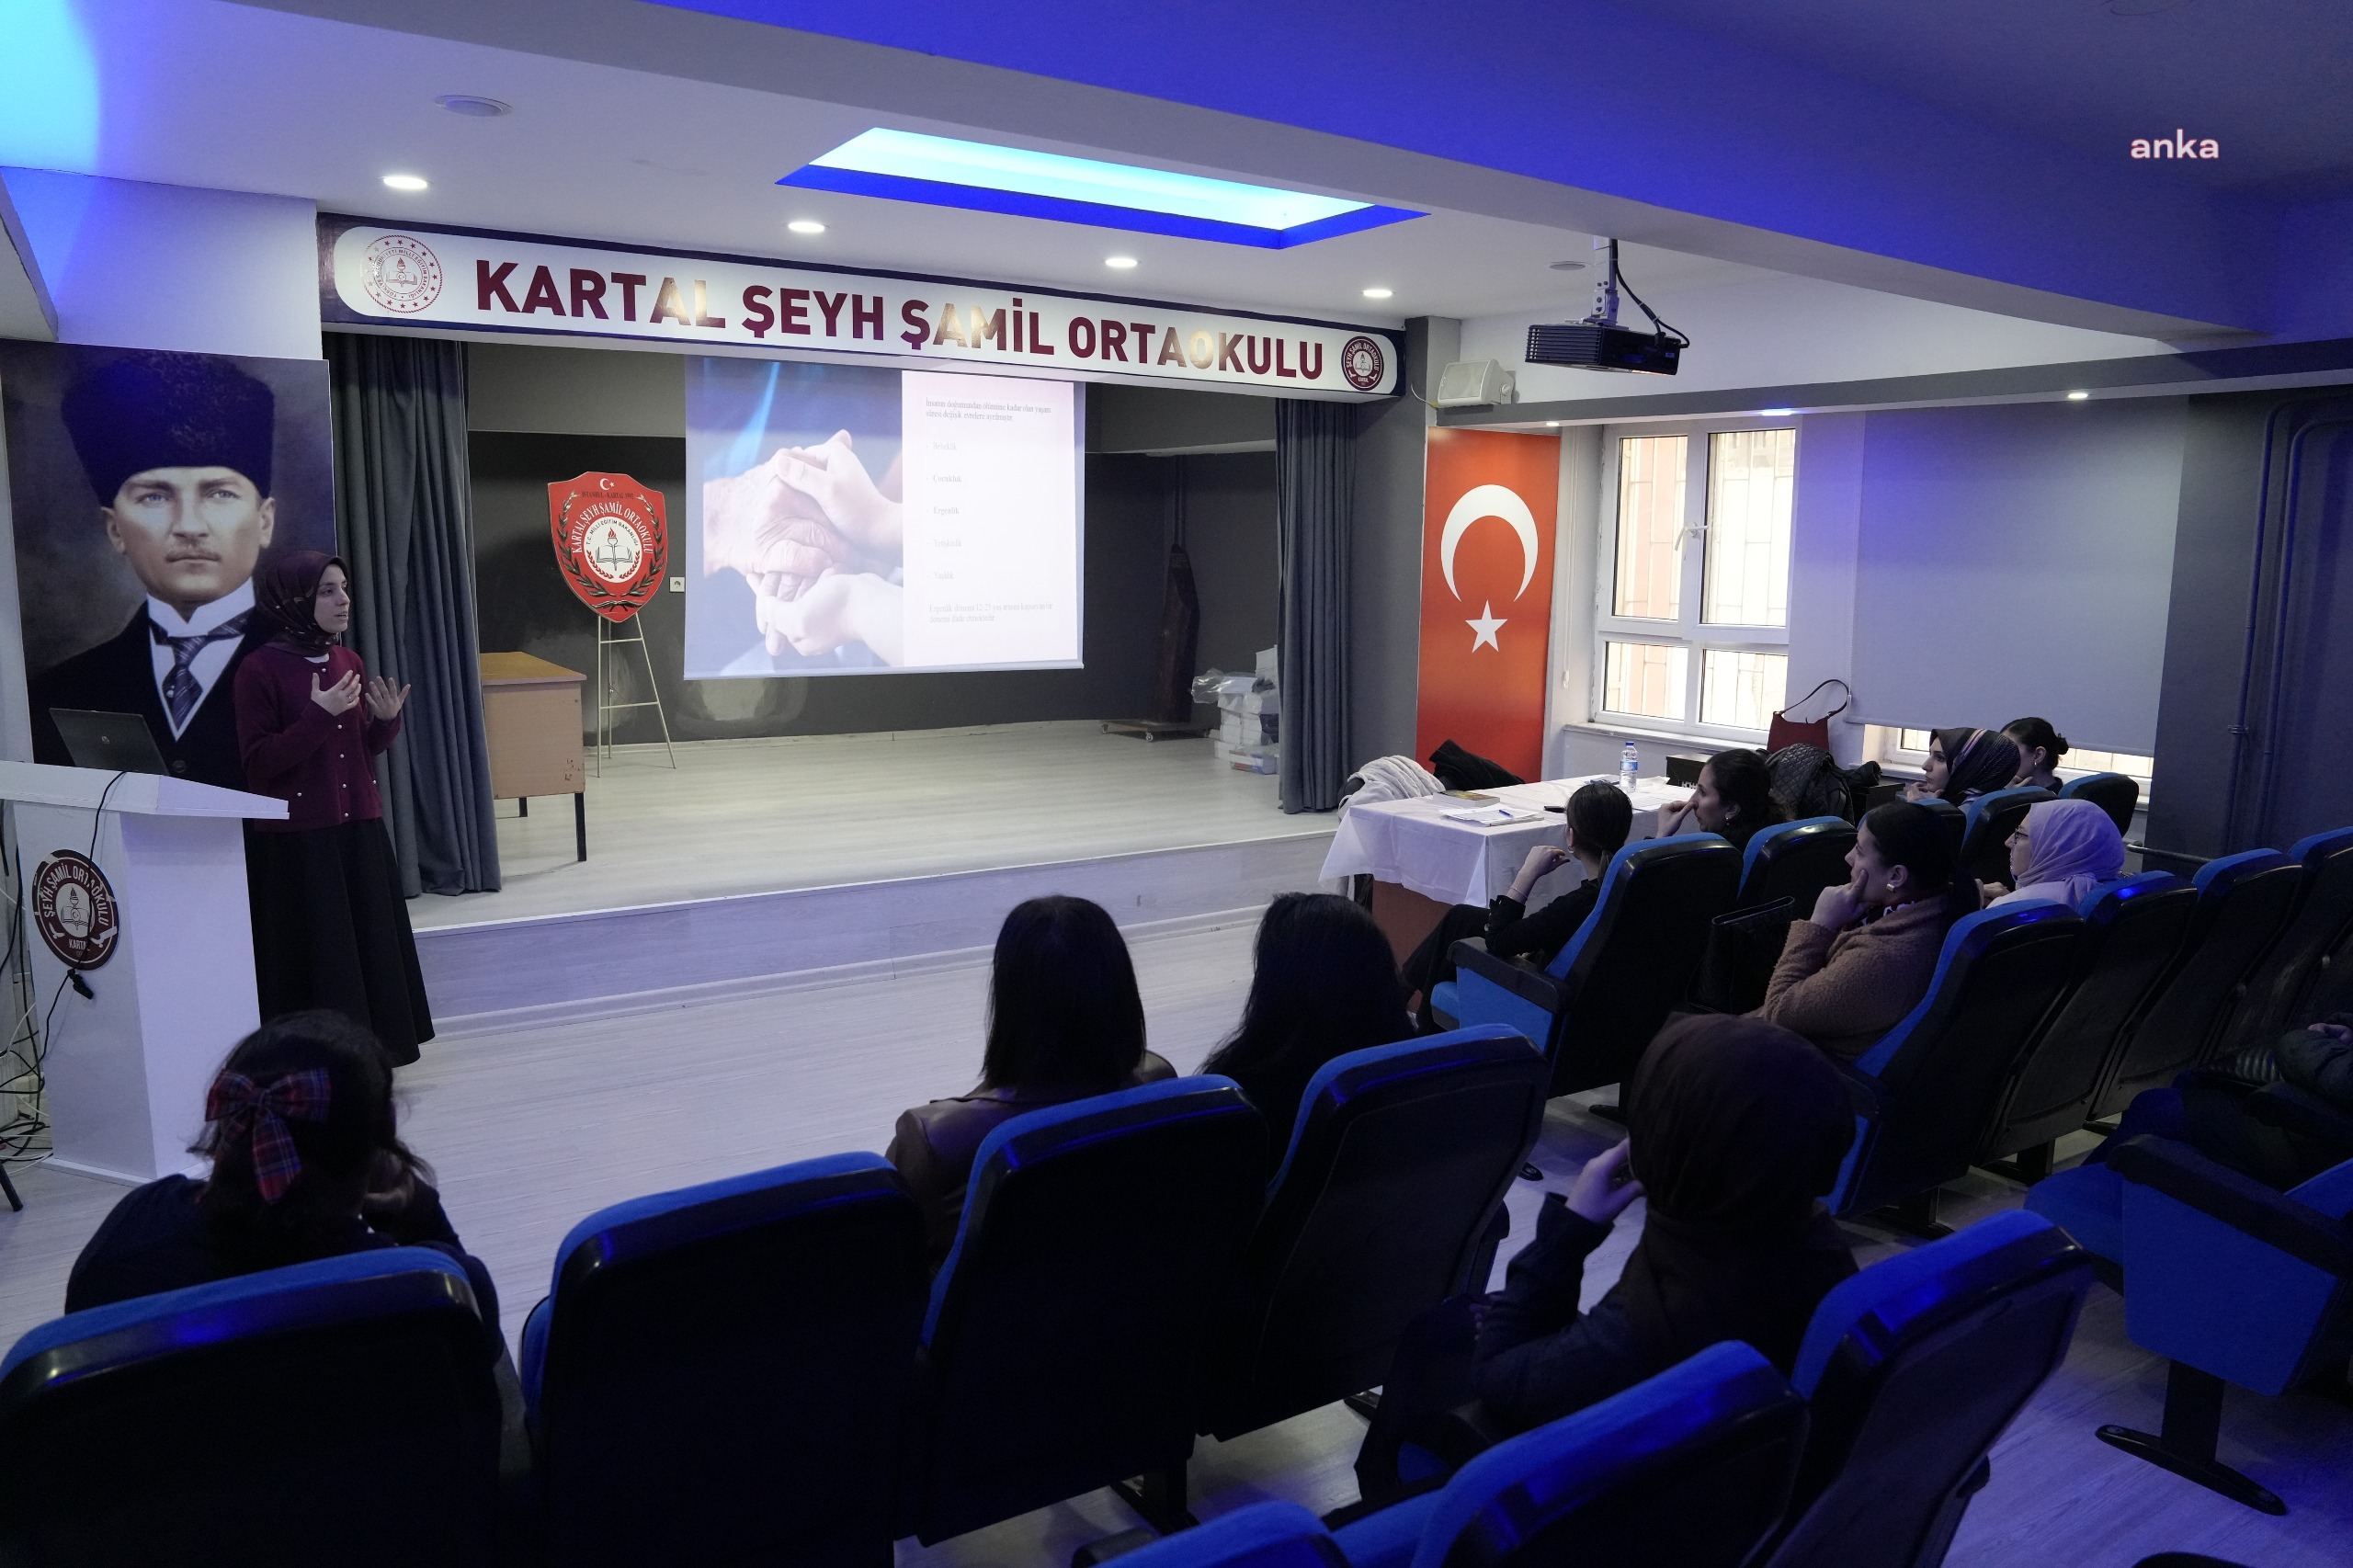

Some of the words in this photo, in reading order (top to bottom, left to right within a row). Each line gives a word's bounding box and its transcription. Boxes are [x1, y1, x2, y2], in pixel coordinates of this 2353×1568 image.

[476, 259, 726, 329] KARTAL
[741, 284, 884, 341] ŞEYH
[900, 296, 1055, 357] ŞAMİL
[1068, 316, 1323, 381] ORTAOKULU
[571, 520, 586, 553] KARTAL
[579, 504, 600, 526] ŞEYH
[598, 500, 623, 517] ŞAMİL
[623, 507, 654, 554] ORTAOKULU
[47, 863, 72, 891] ŞAMİL
[42, 886, 56, 918] ŞEYH
[69, 938, 90, 951] KARTA
